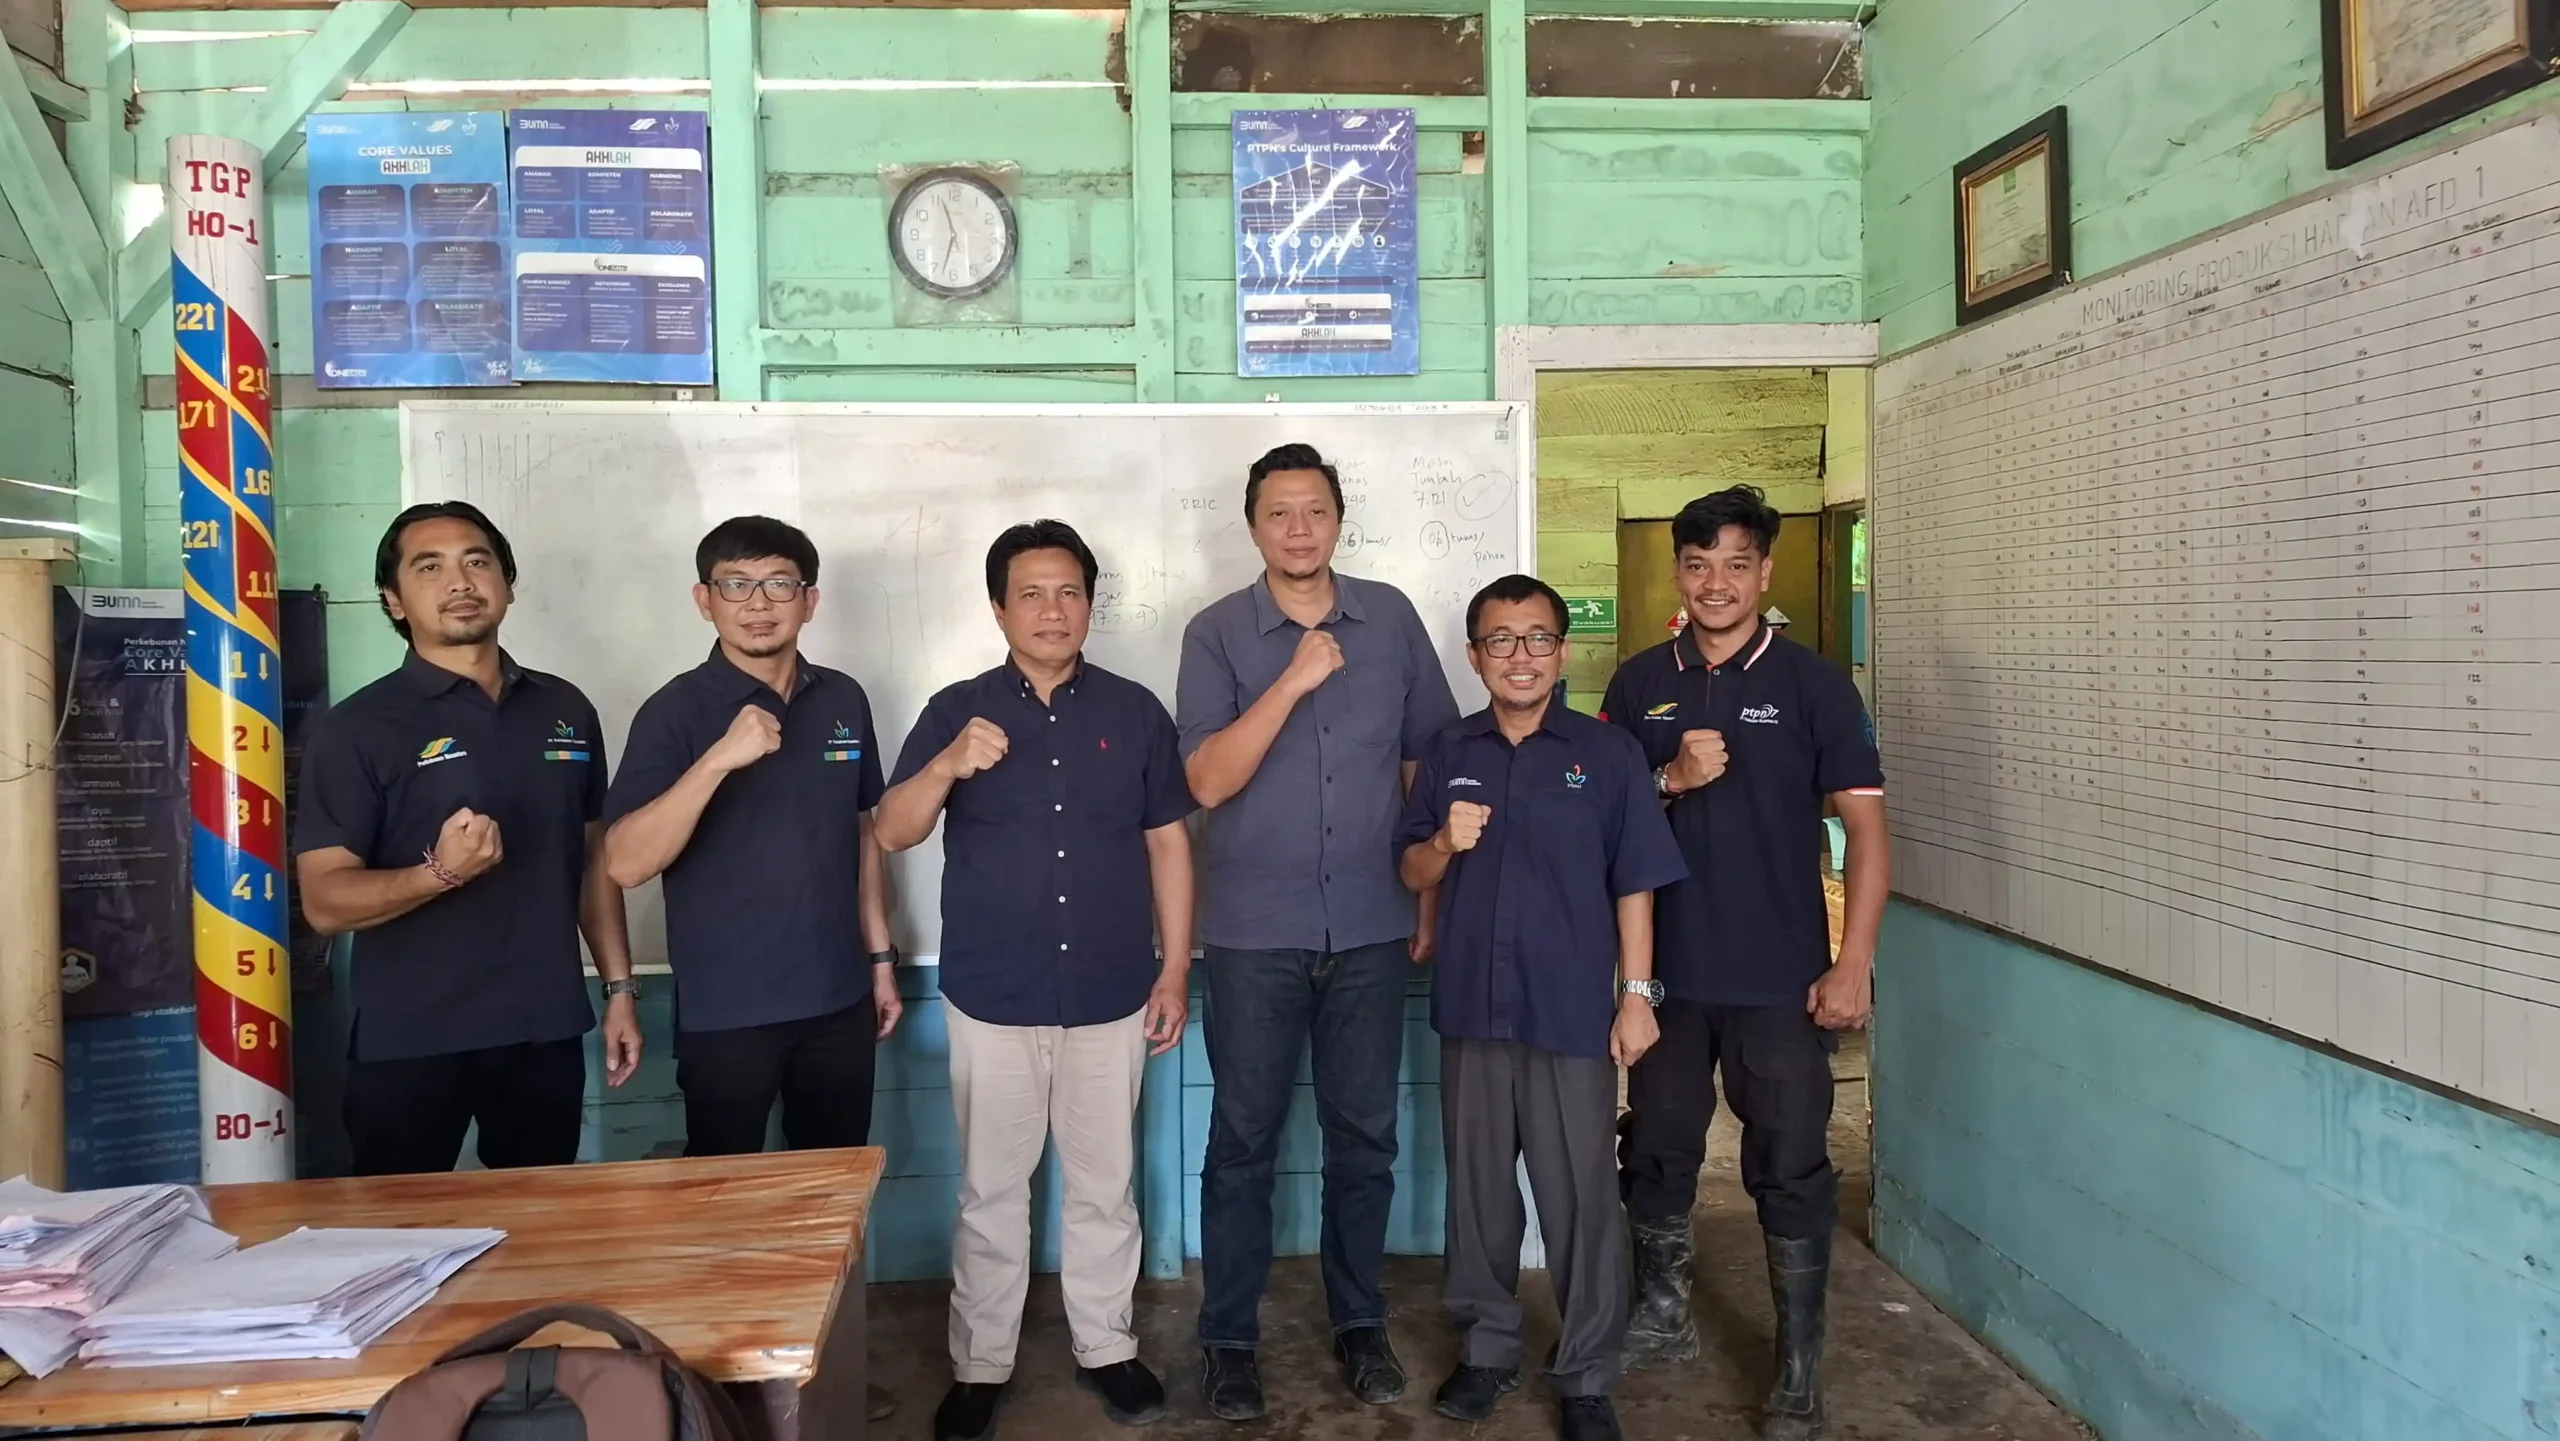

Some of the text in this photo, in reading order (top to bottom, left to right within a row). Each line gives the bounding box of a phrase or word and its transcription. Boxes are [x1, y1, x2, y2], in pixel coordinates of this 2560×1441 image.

[359, 144, 453, 157] CORE VALUES
[1247, 144, 1287, 153] PTPN's
[1289, 143, 1331, 153] Culture
[586, 151, 632, 164] AKHLAK
[383, 160, 429, 173] AKHLAK
[185, 161, 252, 199] TGP
[949, 189, 961, 202] 12
[916, 209, 928, 222] 10
[985, 212, 995, 225] 2
[188, 210, 259, 246] HO-1
[910, 229, 919, 241] 9
[917, 249, 925, 261] 8
[2083, 269, 2188, 326] MONITORING
[2195, 234, 2297, 293] PRODUKSI
[2407, 177, 2457, 222] AFD
[949, 269, 958, 281] 6
[92, 595, 142, 609] BUMN
[124, 638, 178, 646] Perkebunan
[124, 646, 165, 659] Core
[231, 725, 248, 751] 2
[235, 799, 250, 825] 3
[231, 874, 252, 901] 4
[237, 950, 255, 976] 5
[238, 1024, 258, 1050] 6
[216, 1110, 287, 1141] BO-1
